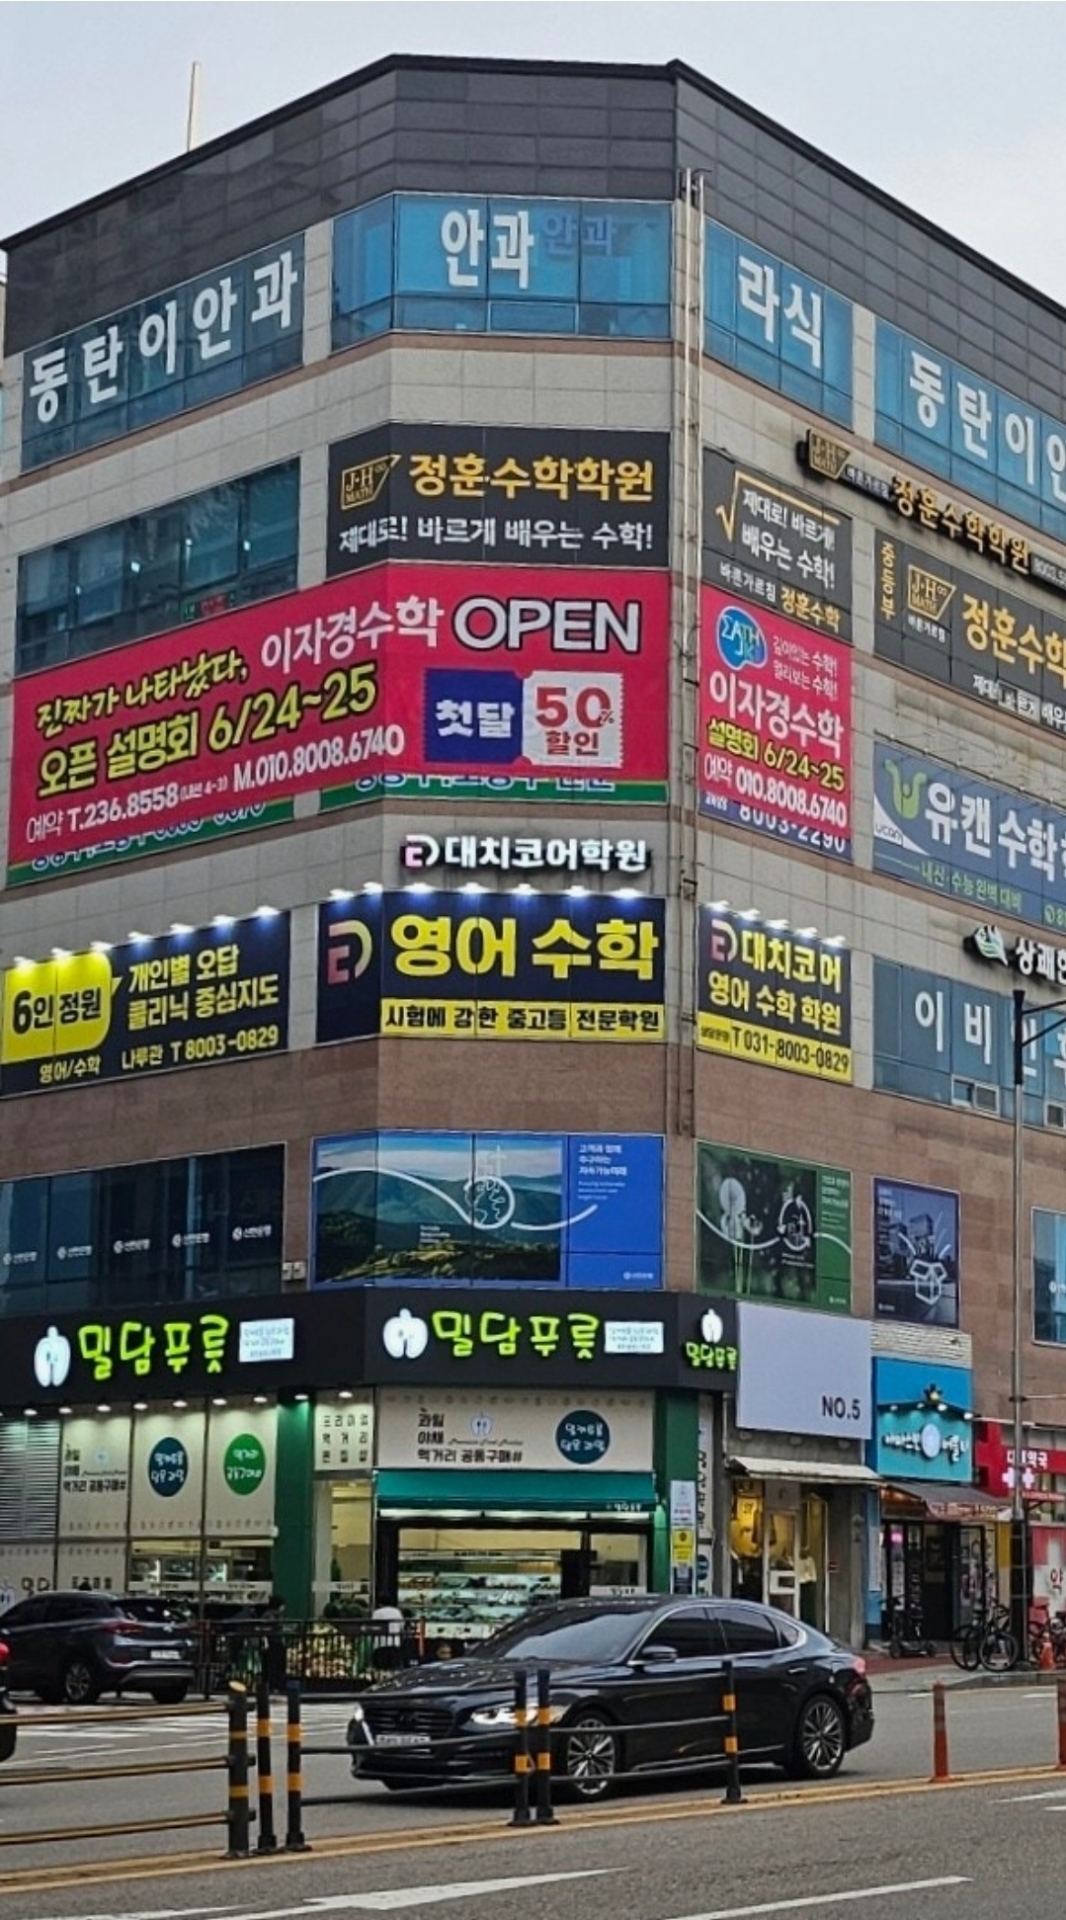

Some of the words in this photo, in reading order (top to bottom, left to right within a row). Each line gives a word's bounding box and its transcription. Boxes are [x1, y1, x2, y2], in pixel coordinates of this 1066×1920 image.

[441, 209, 534, 290] 안과
[30, 250, 298, 423] 동탄이안과
[738, 255, 821, 369] 라식
[409, 453, 653, 502] 정훈수학학원
[339, 516, 407, 553] 제대로!
[418, 516, 496, 546] 바르게
[504, 519, 584, 549] 배우는
[592, 522, 653, 551] 수학!
[791, 511, 835, 551] 바르게
[893, 475, 1029, 575] 정훈수학학원
[742, 522, 792, 572] 배우는
[797, 550, 835, 589] 수학!
[781, 585, 840, 633] 정훈수학
[261, 595, 444, 673] 이자경수학
[453, 596, 641, 653] OPEN
[37, 690, 119, 738] 진짜가
[436, 699, 515, 738] 첫달
[535, 686, 614, 728] 50%
[709, 671, 844, 760] 이자경수학
[37, 741, 98, 797] 오픈
[107, 712, 199, 779] 설명회
[546, 730, 599, 756] 할인
[707, 718, 759, 762] 설명회
[704, 753, 732, 788] 예약
[26, 808, 62, 844] 예약
[67, 782, 179, 831] T.236.8558
[924, 782, 991, 858] 유캔
[445, 836, 647, 871] 대치코어학원
[128, 954, 190, 993] 개인별
[197, 944, 239, 980] 오답
[391, 914, 516, 978] 영어
[532, 919, 659, 980] 수학
[742, 930, 841, 994] 대치코어
[128, 990, 188, 1031] 클리닉
[196, 974, 279, 1019] 중심지도
[386, 1005, 446, 1028] 시험에
[454, 1006, 498, 1029] 강한
[507, 1007, 567, 1030] 중고등
[576, 1010, 660, 1031] 전문학원
[709, 970, 749, 1012] 영어
[756, 985, 796, 1023] 수학
[802, 996, 841, 1036] 학원
[40, 1056, 100, 1084] 영어/수학
[122, 1041, 162, 1070] 나루관
[171, 1041, 182, 1062] T
[185, 1025, 279, 1060] 8003-0829
[731, 1026, 741, 1047] T
[744, 1031, 849, 1074] 031-8003-0829
[432, 1310, 600, 1359] 밀담푸릇
[822, 1395, 861, 1421] NO.5
